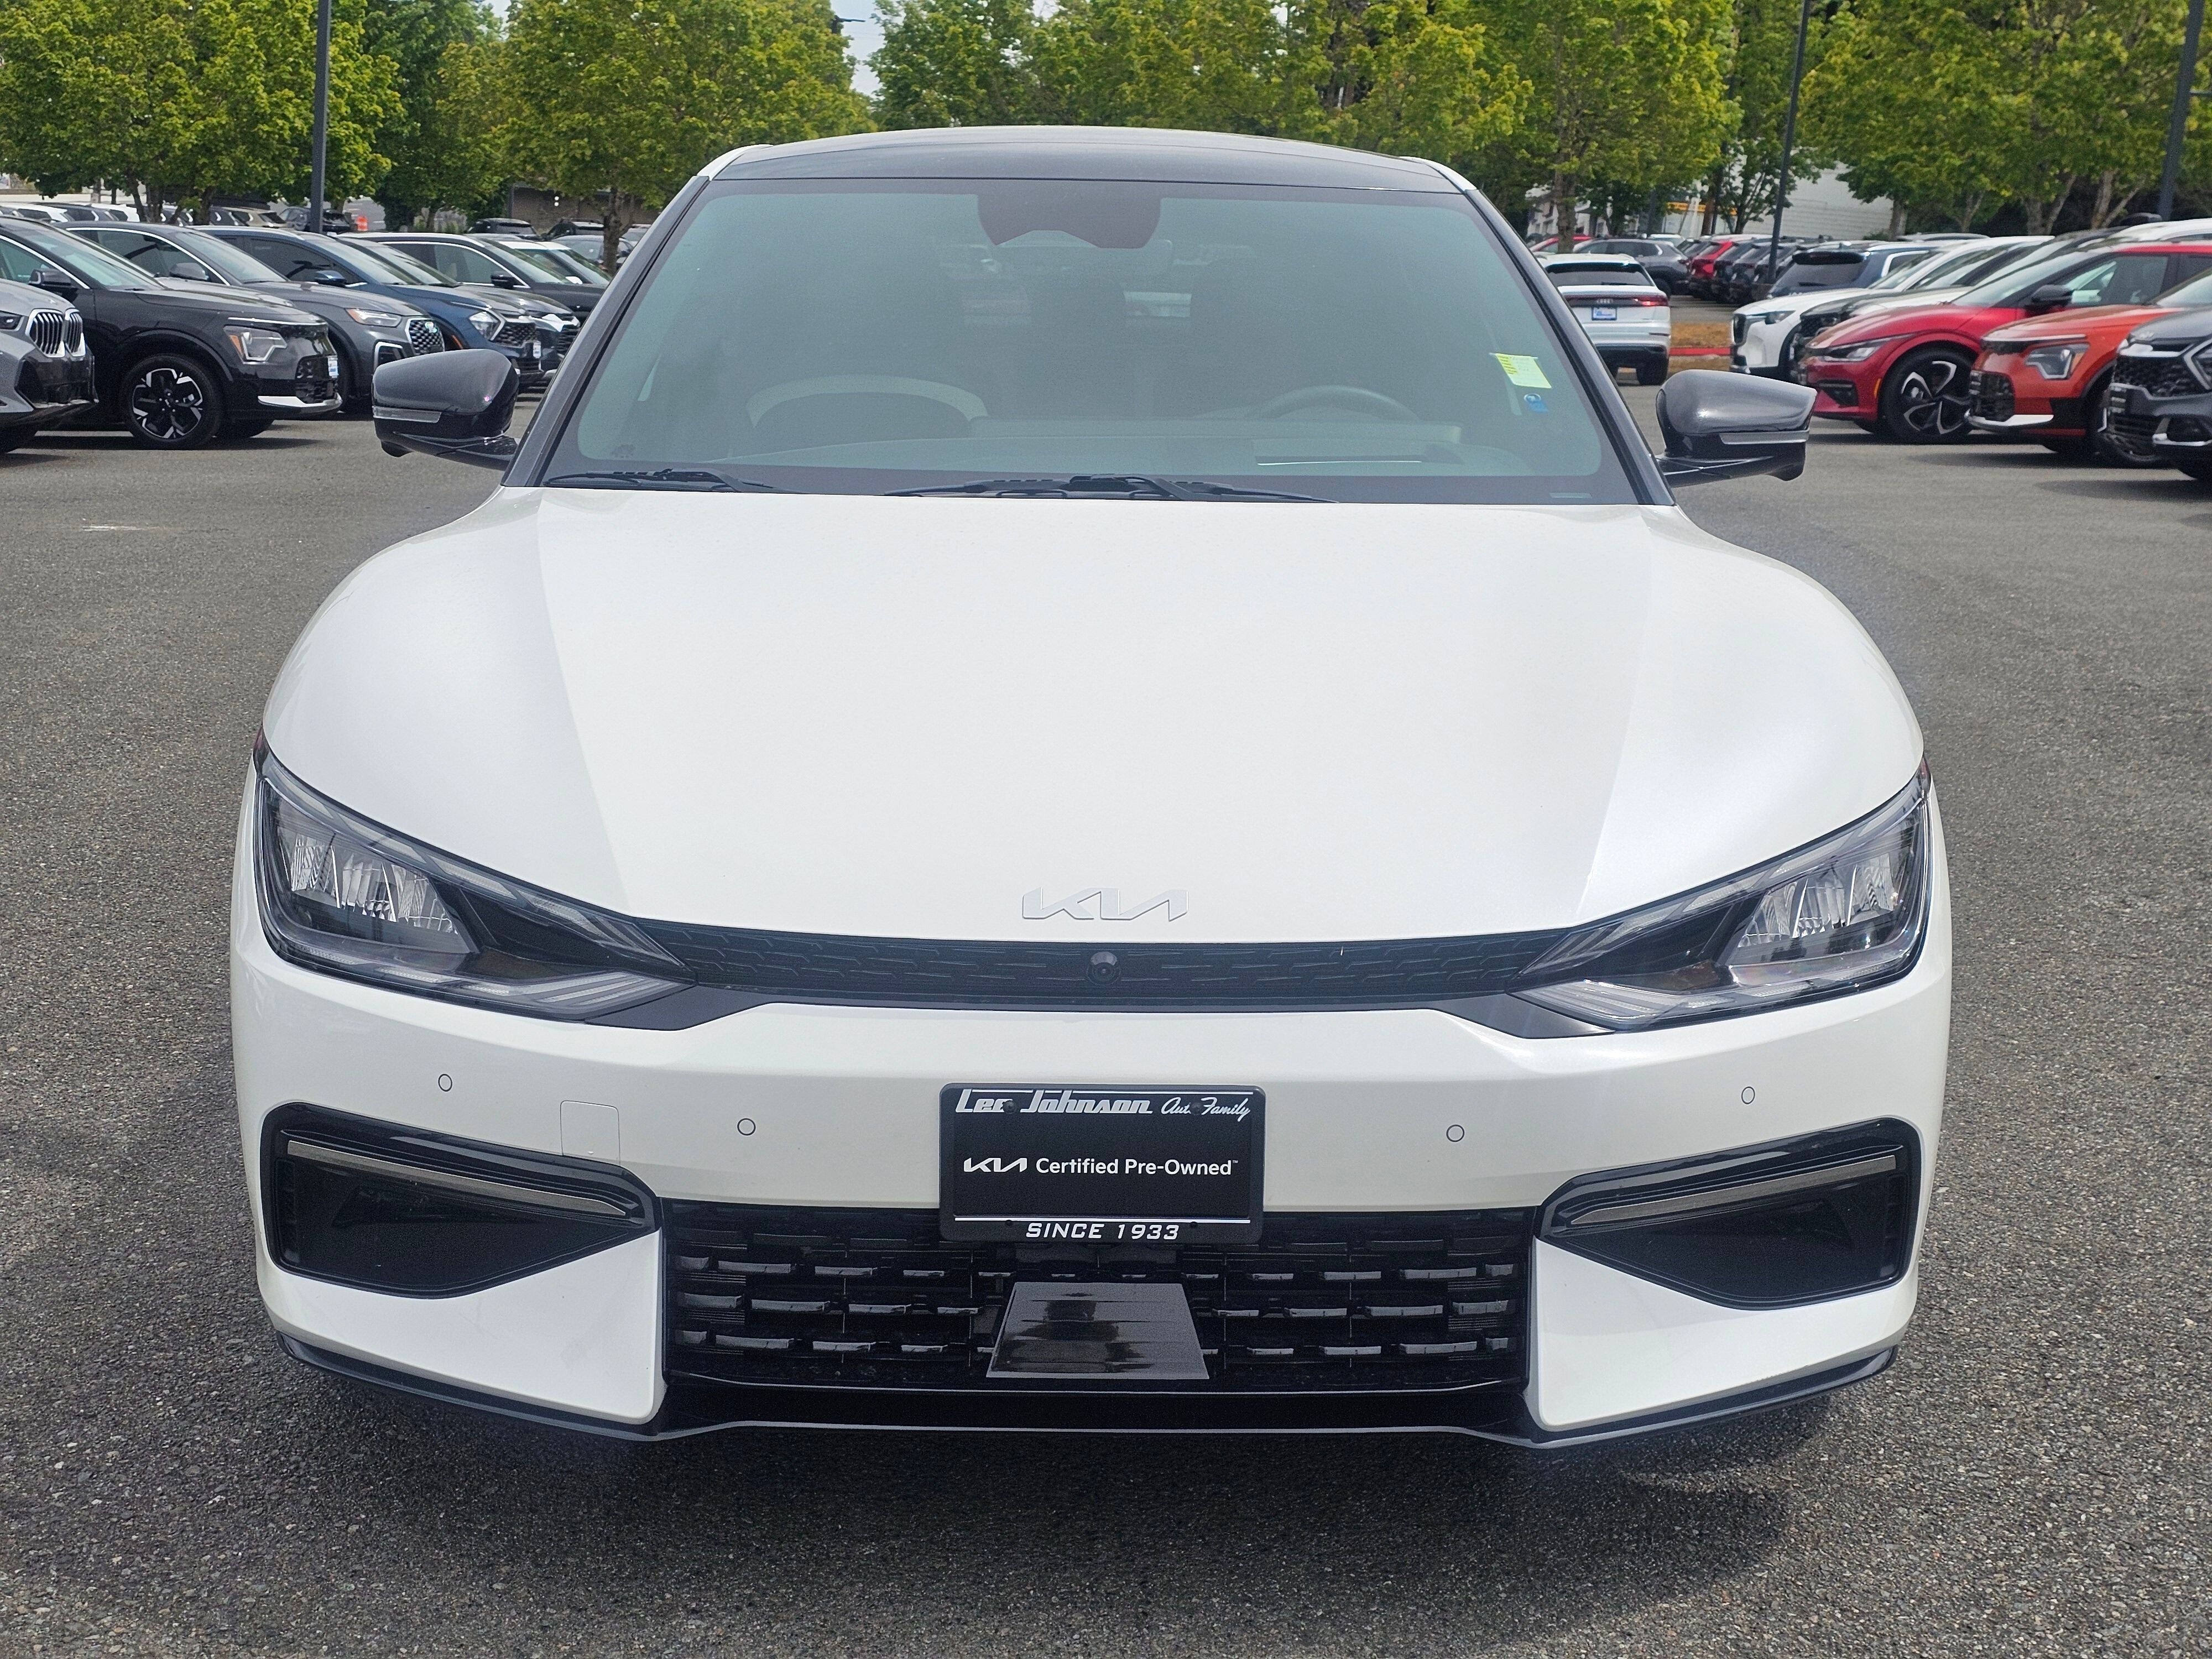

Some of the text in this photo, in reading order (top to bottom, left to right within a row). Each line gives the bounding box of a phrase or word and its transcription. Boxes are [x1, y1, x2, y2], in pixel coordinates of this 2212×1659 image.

[1022, 885, 1188, 922] KIA
[1020, 1089, 1153, 1114] Johnson
[1161, 1097, 1193, 1115] Aut
[1201, 1097, 1251, 1122] Family
[963, 1157, 1027, 1172] KIA
[1036, 1157, 1119, 1174] Certified
[1026, 1223, 1180, 1240] SINCE 1933
